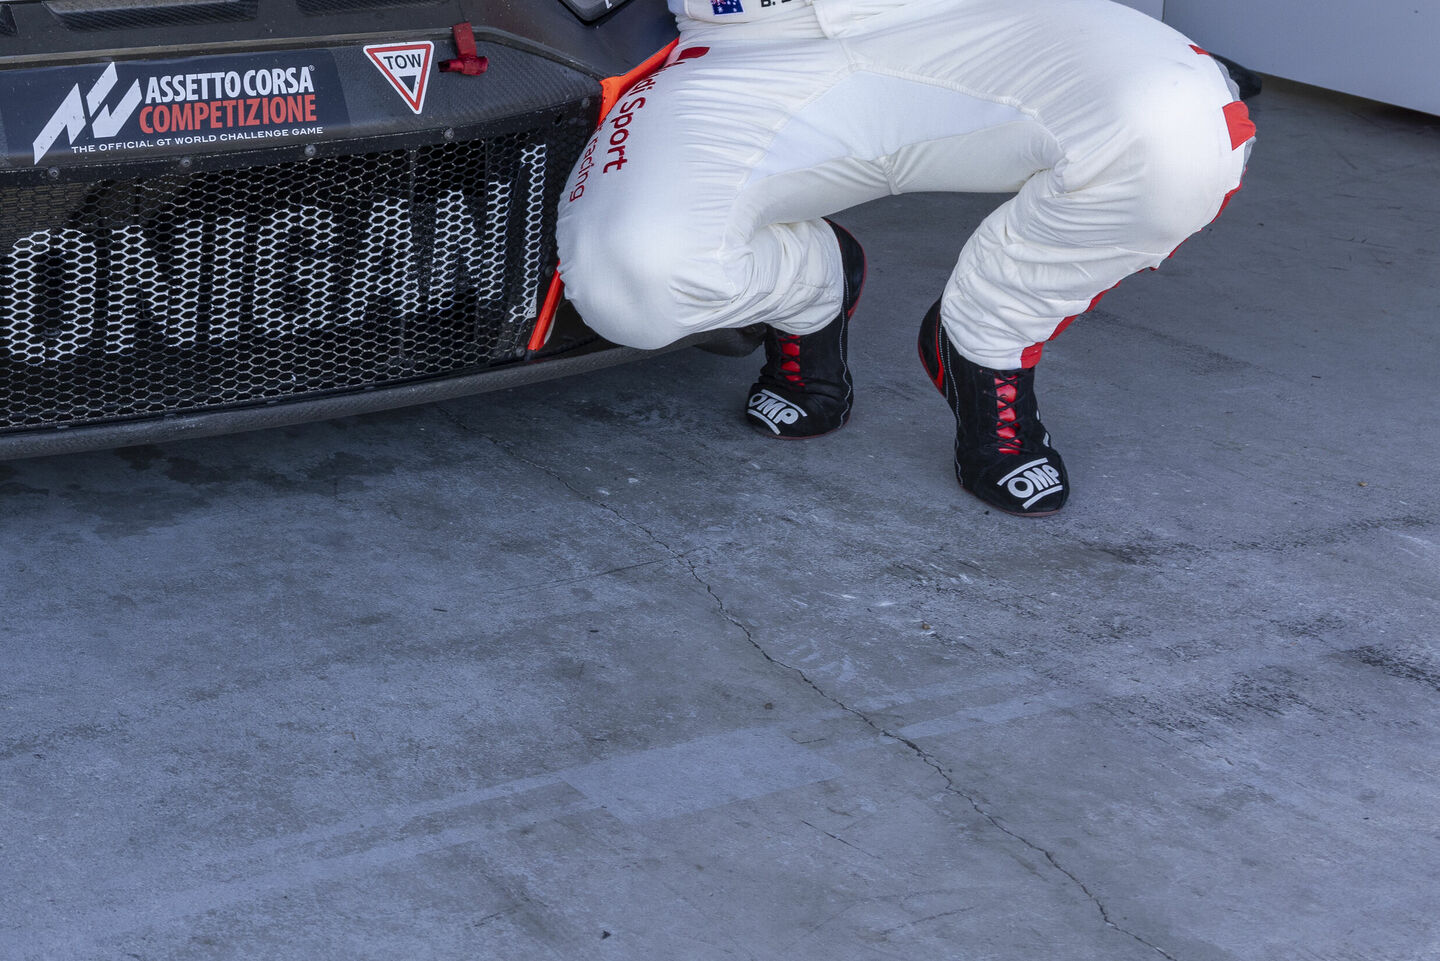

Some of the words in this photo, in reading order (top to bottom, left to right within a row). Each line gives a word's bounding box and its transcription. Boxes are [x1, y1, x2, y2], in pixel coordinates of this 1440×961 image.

[384, 53, 423, 70] TOW
[144, 71, 237, 104] ASSETTO
[139, 94, 318, 134] COMPETIZIONE
[71, 144, 96, 153] THE
[99, 140, 154, 151] OFFICIAL
[157, 138, 173, 146] GT
[175, 134, 218, 145] WORLD
[220, 129, 289, 141] CHALLENGE
[292, 126, 324, 135] GAME
[603, 97, 646, 174] Sport
[749, 392, 800, 426] OMP
[1006, 463, 1060, 499] OMP
